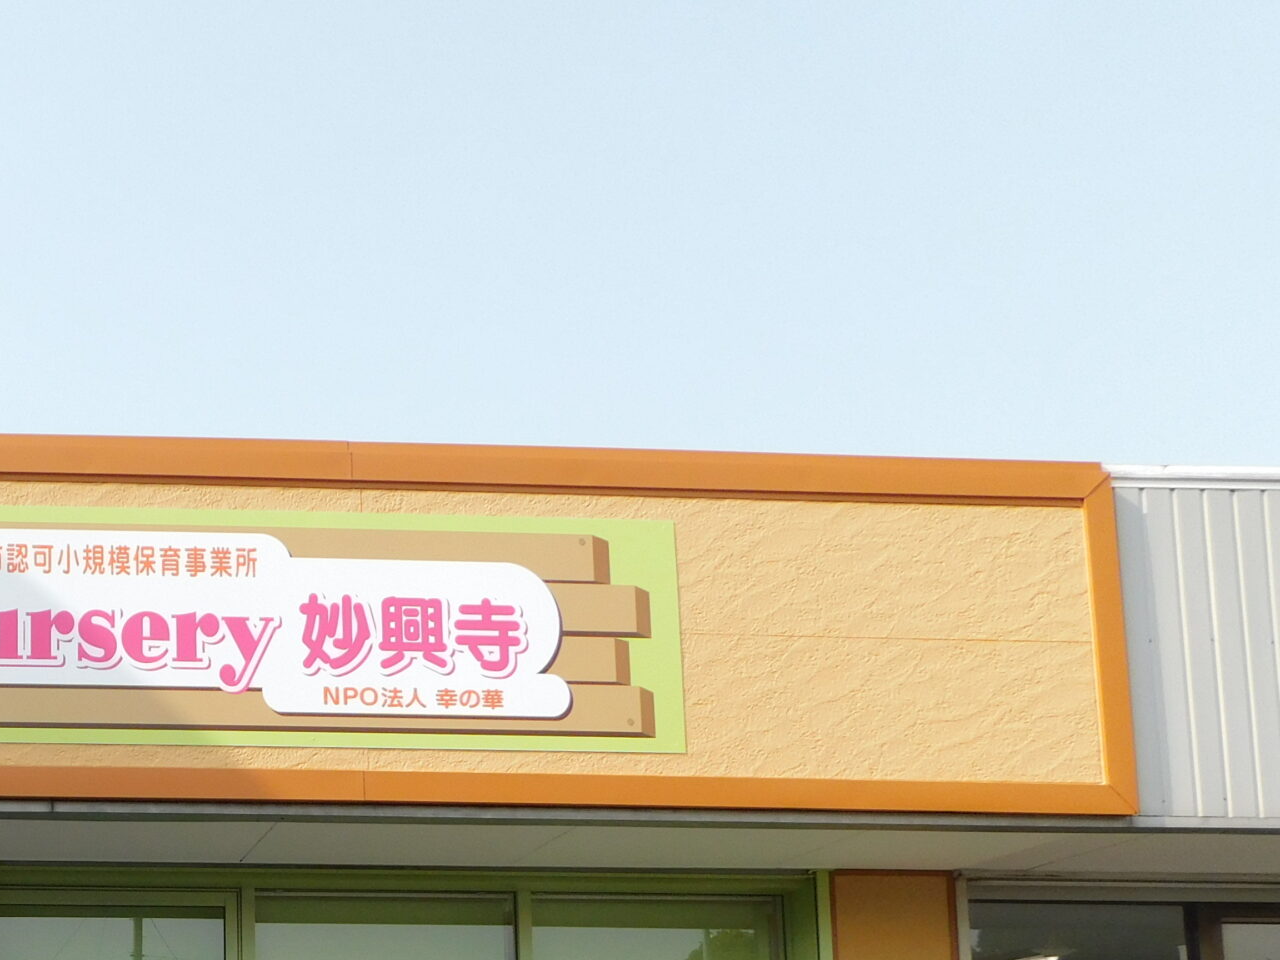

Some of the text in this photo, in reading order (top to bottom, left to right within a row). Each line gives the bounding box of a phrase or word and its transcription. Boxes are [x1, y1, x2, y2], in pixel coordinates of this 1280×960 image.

[299, 593, 524, 675] 妙興寺
[323, 686, 505, 710] NPO法人 幸の華
